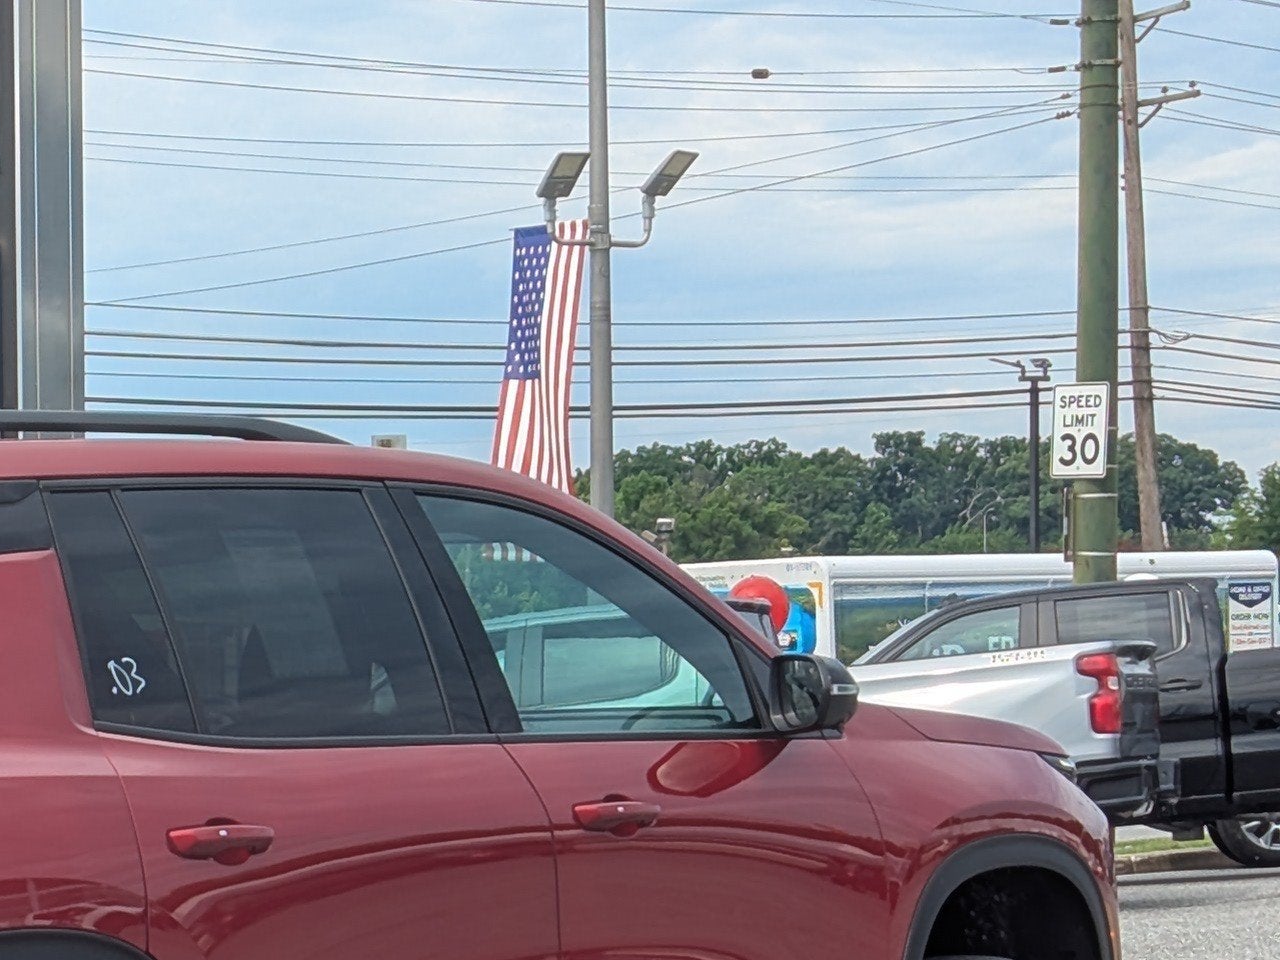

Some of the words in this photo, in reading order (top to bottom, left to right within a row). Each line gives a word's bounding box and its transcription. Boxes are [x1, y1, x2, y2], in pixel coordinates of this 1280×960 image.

[1059, 395, 1102, 409] SPEED
[1062, 414, 1097, 428] LIMIT
[1058, 432, 1100, 467] 30
